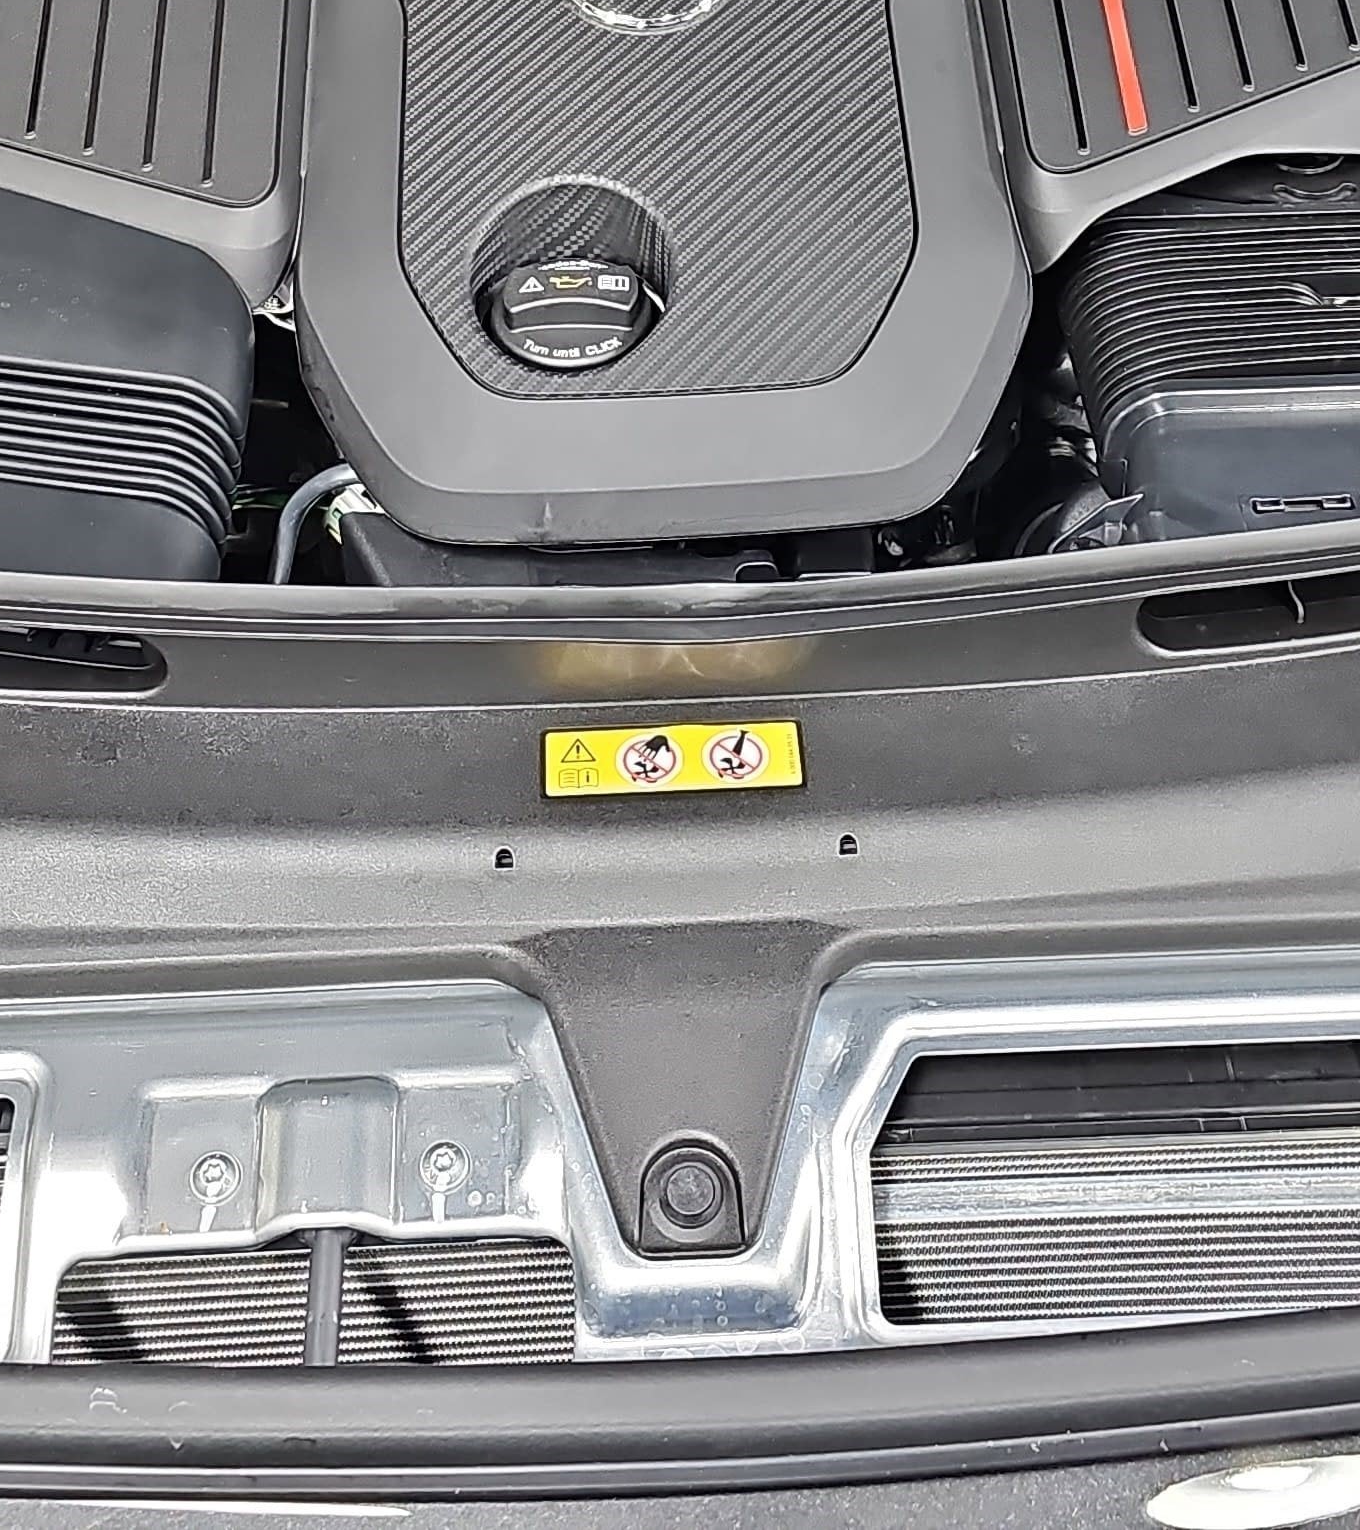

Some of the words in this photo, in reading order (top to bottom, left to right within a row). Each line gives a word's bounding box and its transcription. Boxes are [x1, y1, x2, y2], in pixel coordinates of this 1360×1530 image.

[523, 338, 550, 356] Turn
[552, 347, 581, 358] until
[585, 336, 623, 356] CLICK
